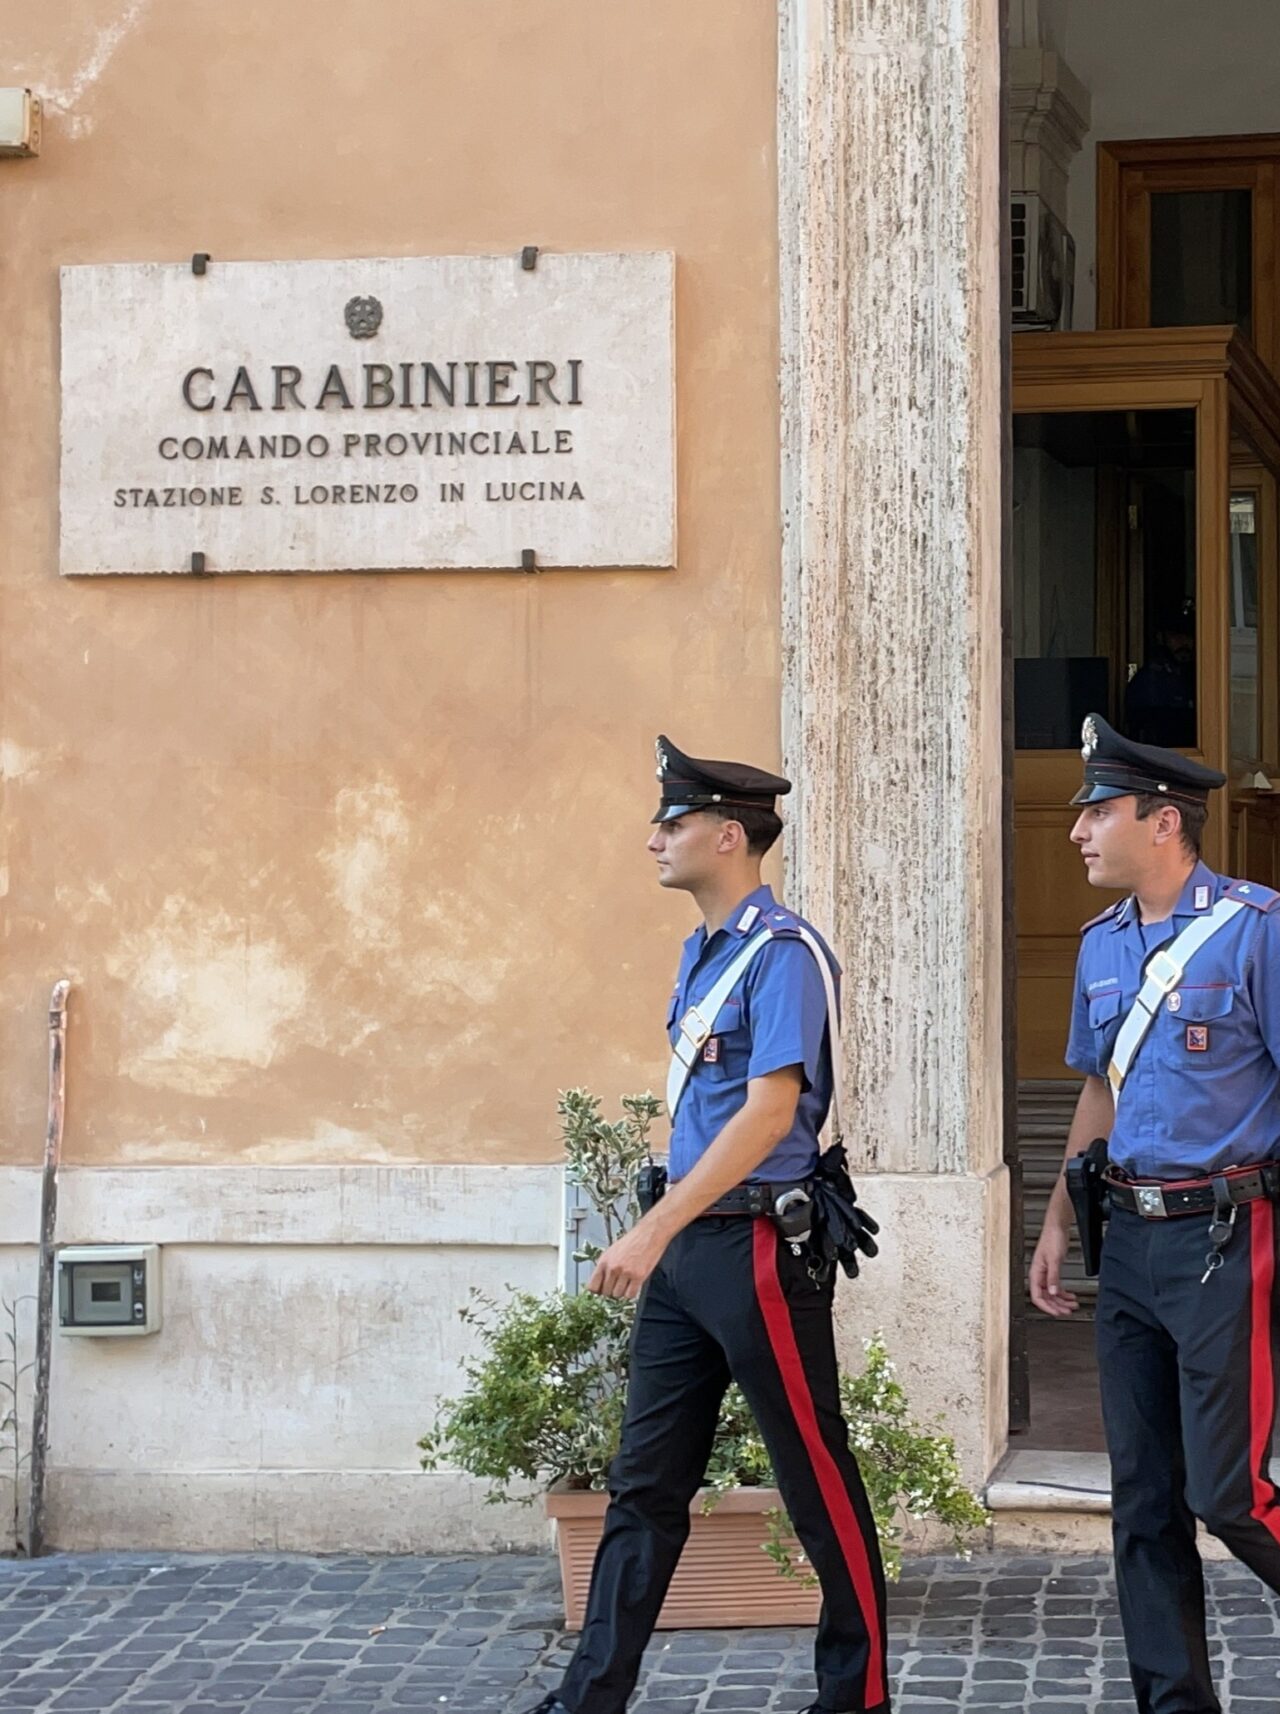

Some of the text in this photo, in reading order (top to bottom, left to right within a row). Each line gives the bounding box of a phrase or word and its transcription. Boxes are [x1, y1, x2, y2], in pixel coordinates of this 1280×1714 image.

[181, 358, 584, 413] CARABINIERI
[157, 429, 574, 461] COMANDO PROVINCIALE
[113, 481, 585, 508] STAZIONE S. LORENZO IN LUCINA
